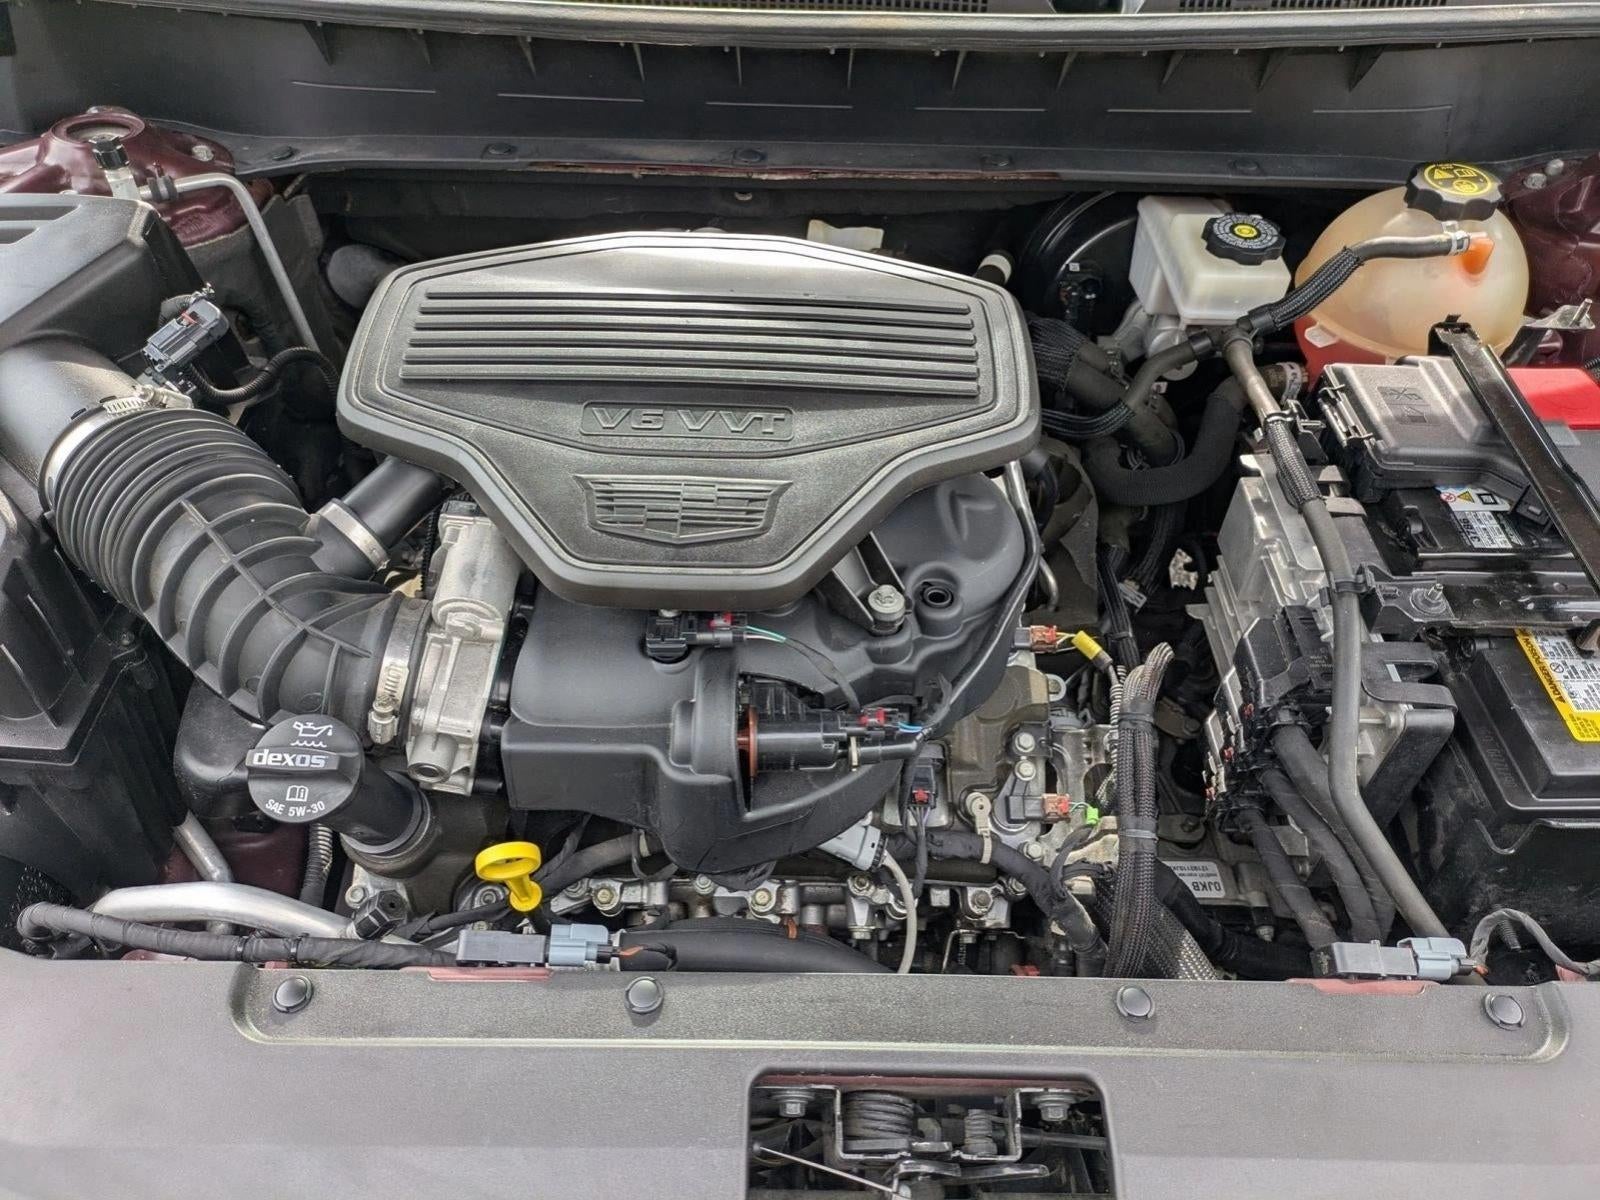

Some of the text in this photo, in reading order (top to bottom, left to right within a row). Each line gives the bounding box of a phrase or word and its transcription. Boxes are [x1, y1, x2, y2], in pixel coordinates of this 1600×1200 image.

[592, 407, 785, 434] V6 VVT
[253, 749, 326, 768] dexos
[265, 799, 325, 816] SAE 5W-30
